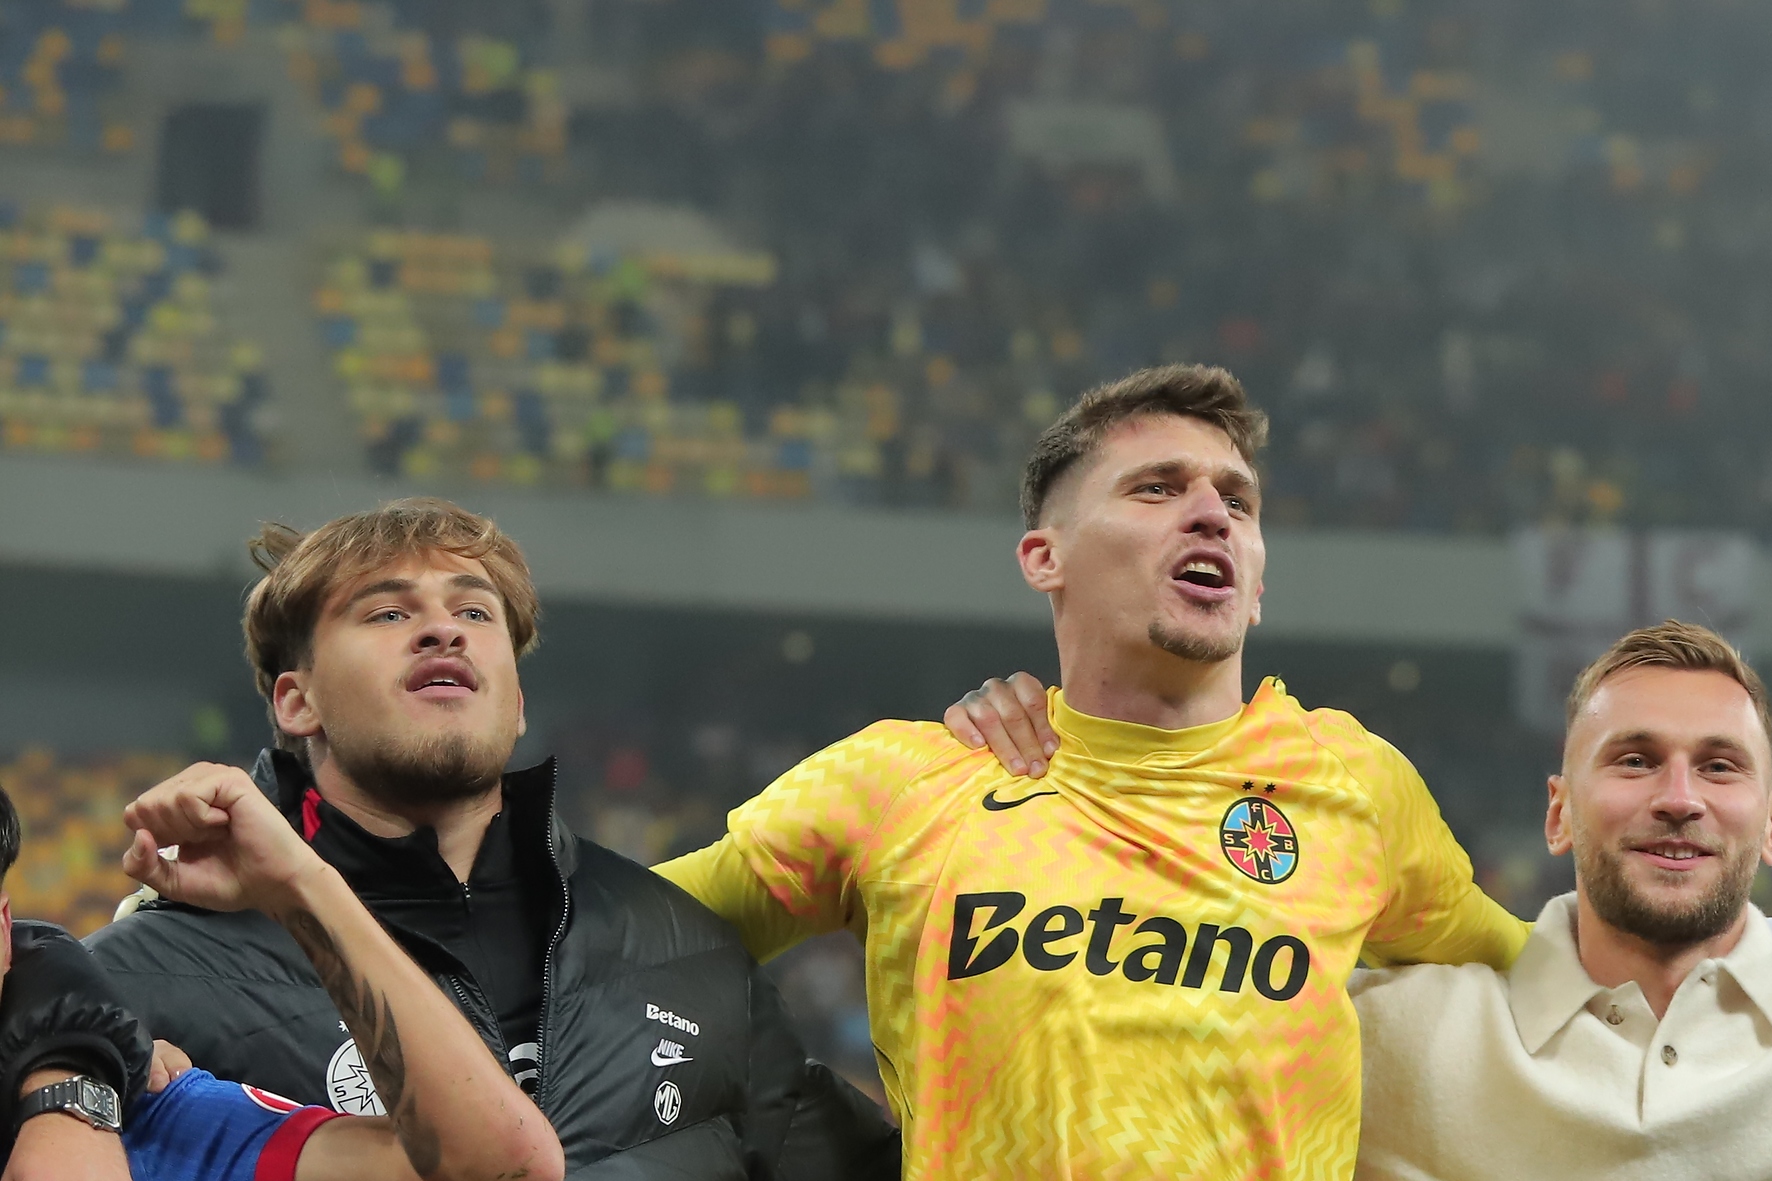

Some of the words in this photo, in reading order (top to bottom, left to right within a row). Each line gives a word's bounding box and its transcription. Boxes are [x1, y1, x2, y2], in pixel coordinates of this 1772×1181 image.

[946, 891, 1310, 1001] Betano
[646, 1003, 700, 1036] Betano
[658, 1039, 685, 1057] NIKE
[656, 1085, 679, 1121] MG
